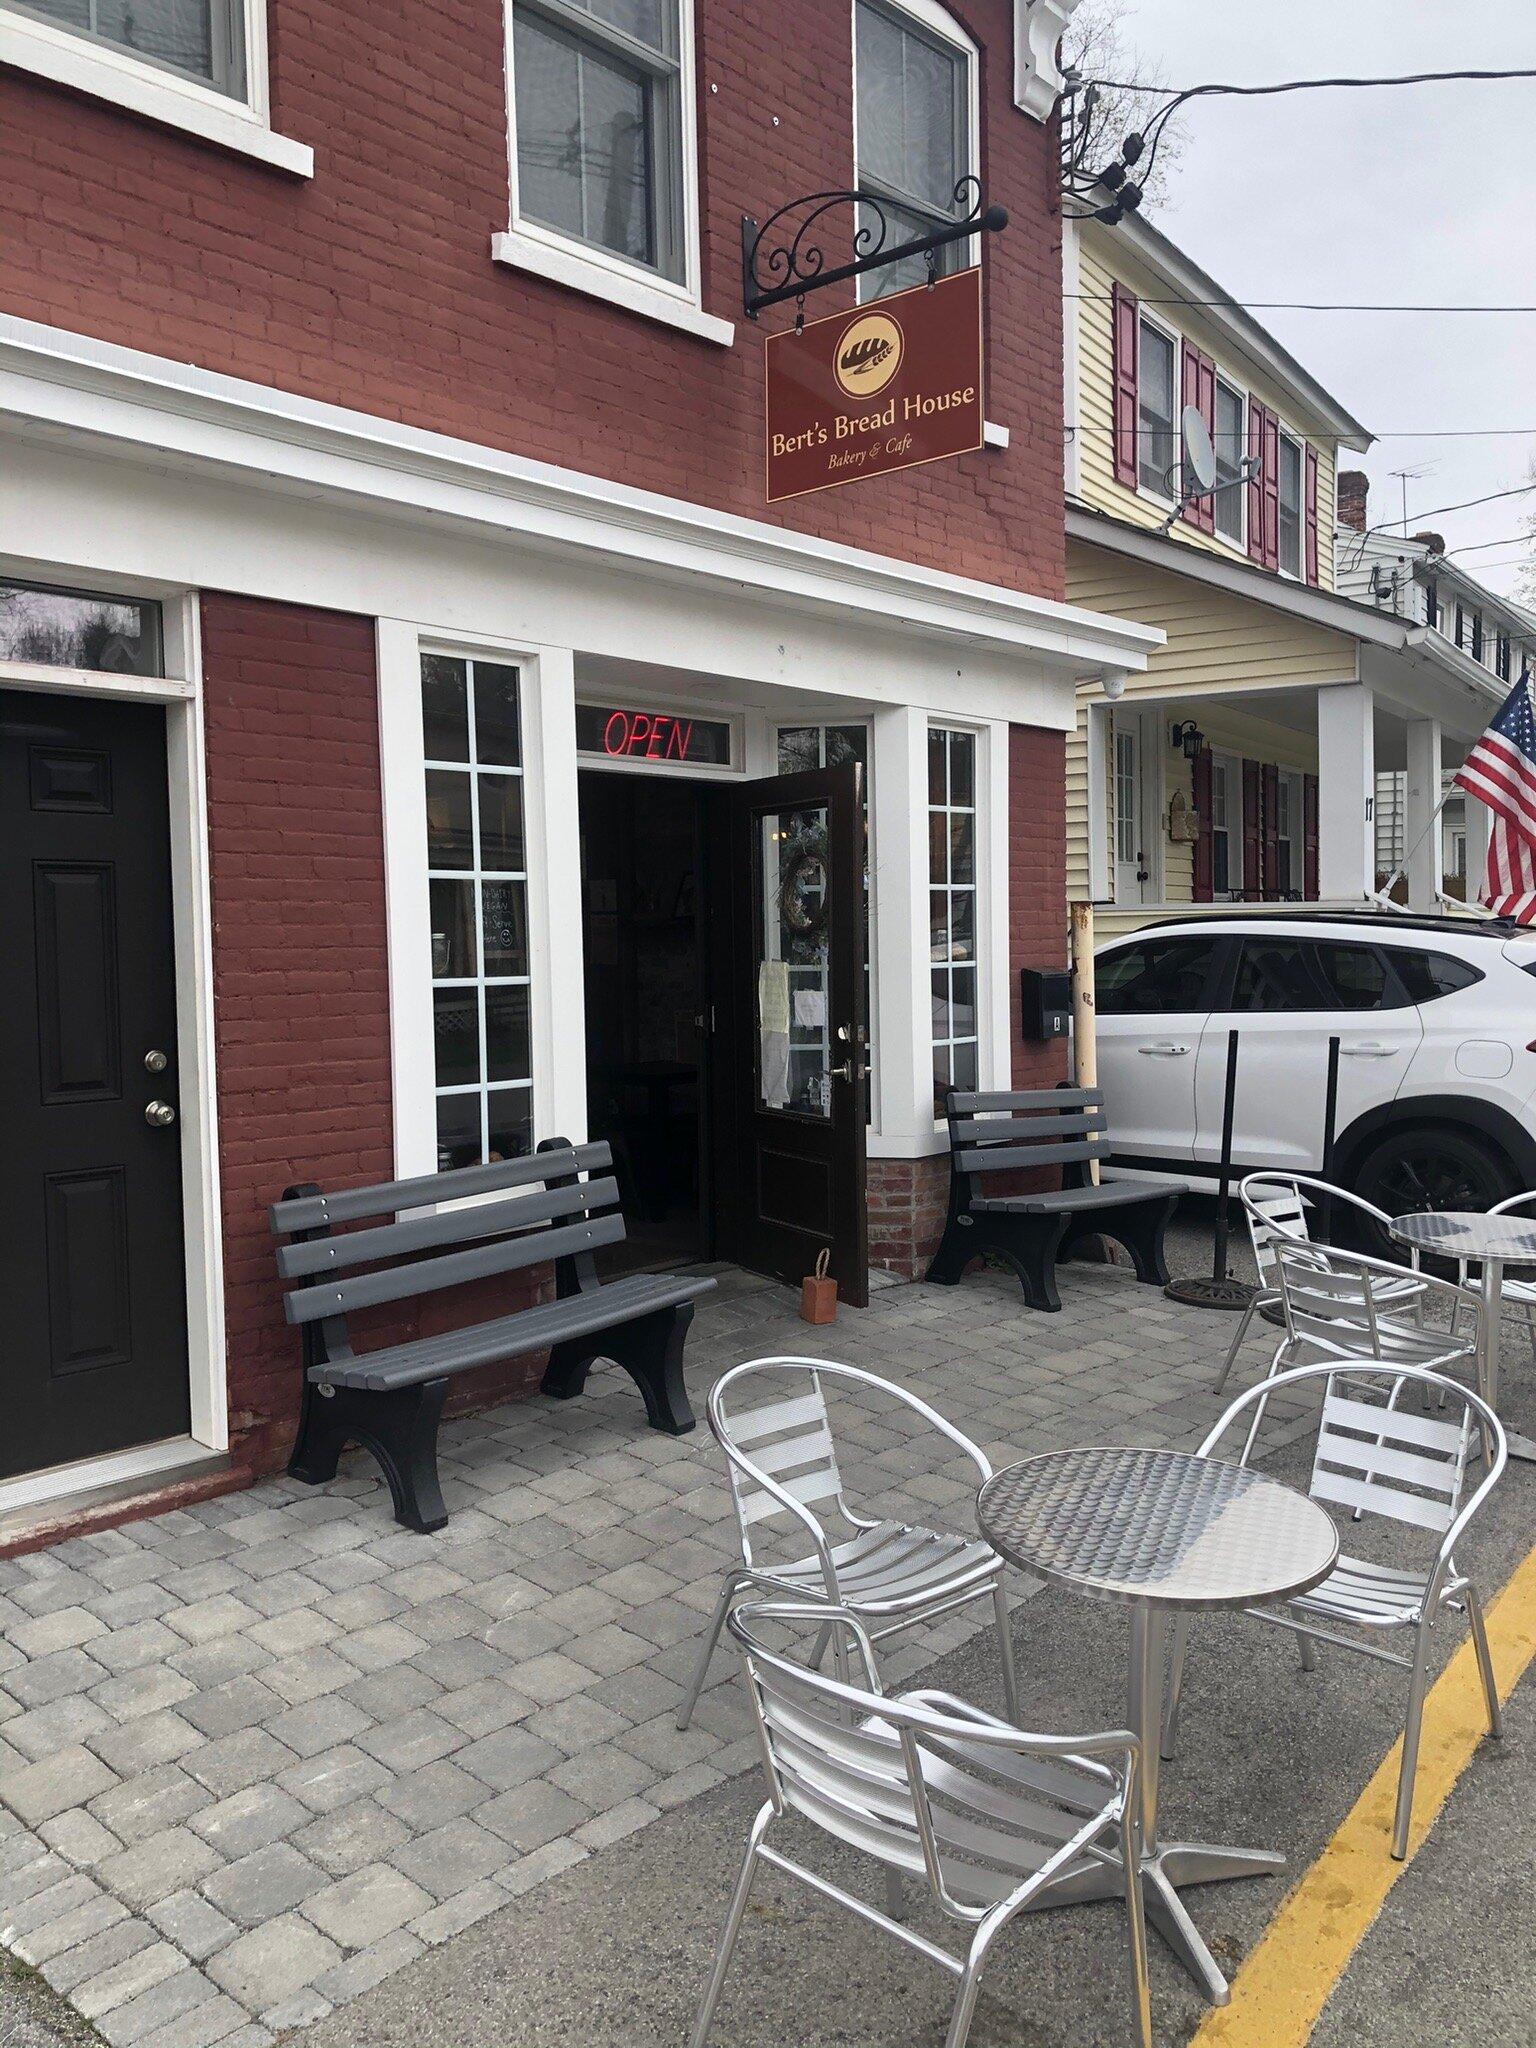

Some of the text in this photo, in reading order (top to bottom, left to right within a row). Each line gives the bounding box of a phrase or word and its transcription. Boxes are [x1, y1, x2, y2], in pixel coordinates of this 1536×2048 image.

[772, 386, 975, 456] Bert's Bread House
[827, 433, 913, 470] Bakery & Cafe
[604, 711, 693, 760] OPEN
